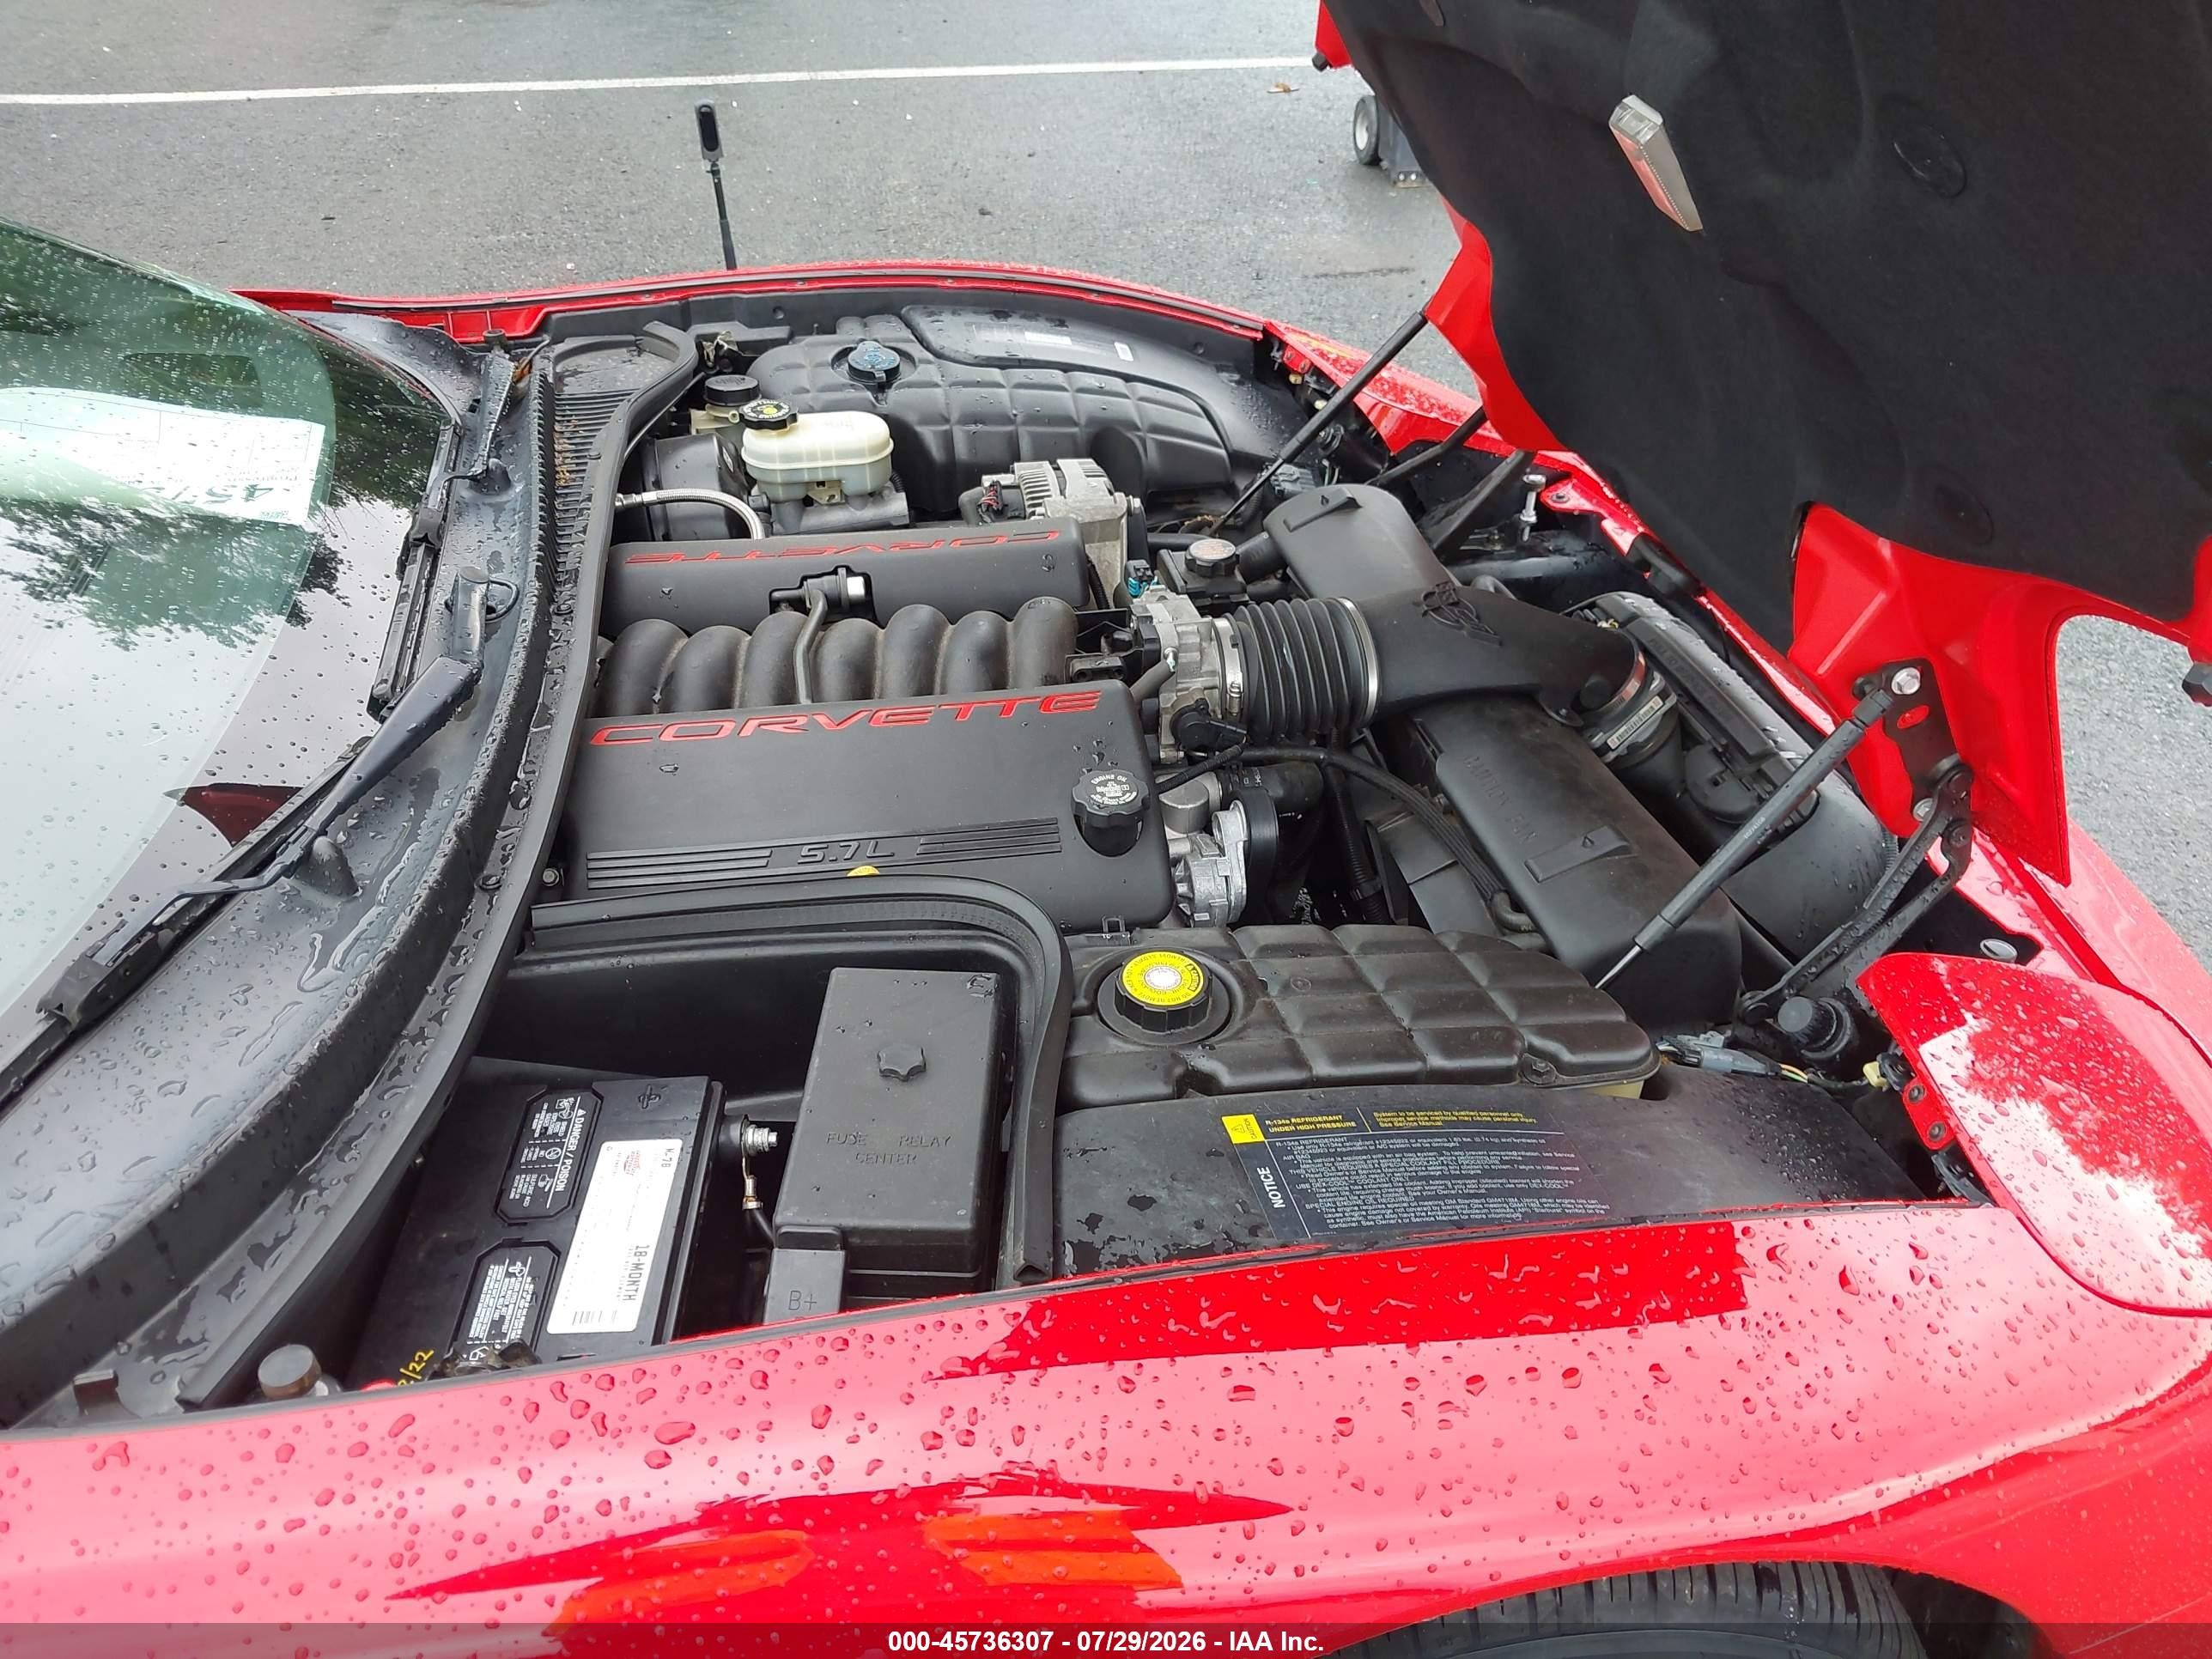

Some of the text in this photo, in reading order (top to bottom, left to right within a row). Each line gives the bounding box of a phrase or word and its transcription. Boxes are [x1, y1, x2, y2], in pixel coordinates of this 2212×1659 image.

[624, 530, 1061, 564] CORVETTE
[589, 690, 1103, 746] CORVETTE
[1091, 774, 1115, 785] ENGINE
[798, 839, 895, 865] 5.7L
[566, 1117, 585, 1151] DANGER
[826, 1132, 952, 1147] FUSE RELAY
[1243, 1118, 1256, 1140] CAUTION
[855, 1152, 918, 1164] CENTER
[554, 1158, 573, 1191] POISON
[1257, 1166, 1285, 1209] NOTICE
[507, 1278, 516, 1288] WITH
[622, 1244, 650, 1302] 18-MONTH
[500, 1278, 510, 1296] MEDICAL
[495, 1297, 504, 1309] HELP
[500, 1278, 522, 1333] FLUSH EYES IMMEDIATELY
[788, 1290, 817, 1310] B+
